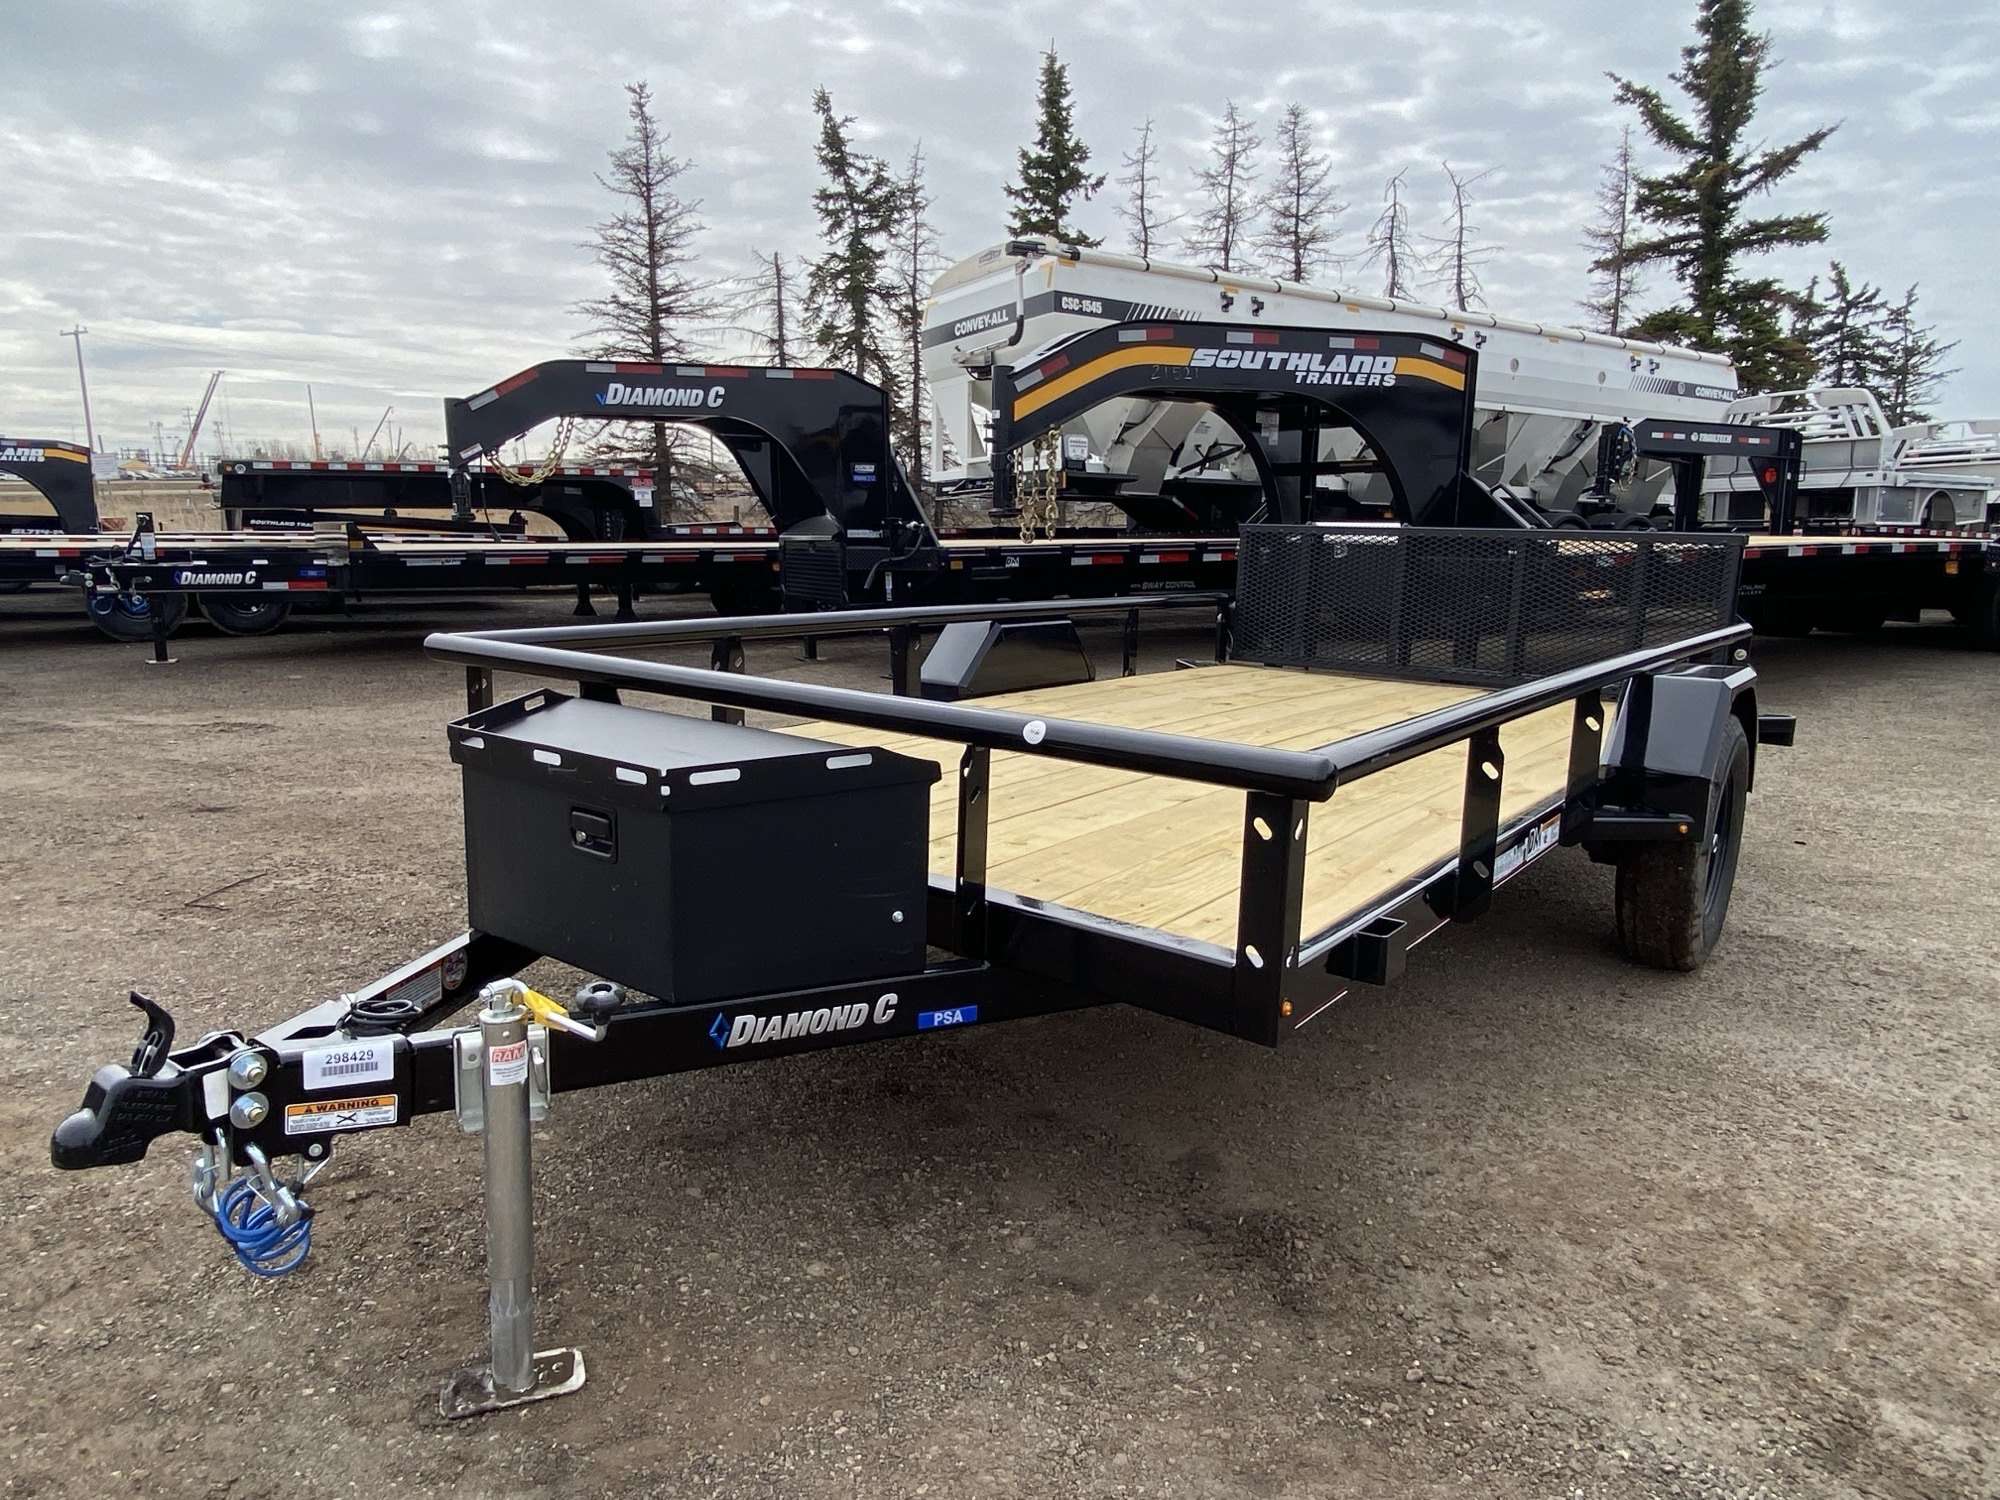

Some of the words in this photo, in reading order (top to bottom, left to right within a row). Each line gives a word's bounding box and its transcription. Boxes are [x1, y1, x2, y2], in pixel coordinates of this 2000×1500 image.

[1061, 296, 1103, 314] CSC-1545
[954, 309, 1009, 336] CONVEY-ALL
[1190, 348, 1397, 374] SOUTHLAND
[1295, 371, 1396, 387] TRAILERS
[605, 383, 704, 407] DIAMOND
[707, 386, 725, 408] C
[250, 519, 295, 527] SOUTHLAND
[180, 571, 242, 585] DIAMOND
[245, 571, 256, 584] C
[727, 1003, 869, 1048] DIAMOND
[873, 993, 898, 1025] C
[934, 1010, 963, 1026] PSA
[325, 1050, 374, 1065] 298429
[492, 1044, 525, 1062] RAM
[316, 1098, 380, 1114] WARNING
